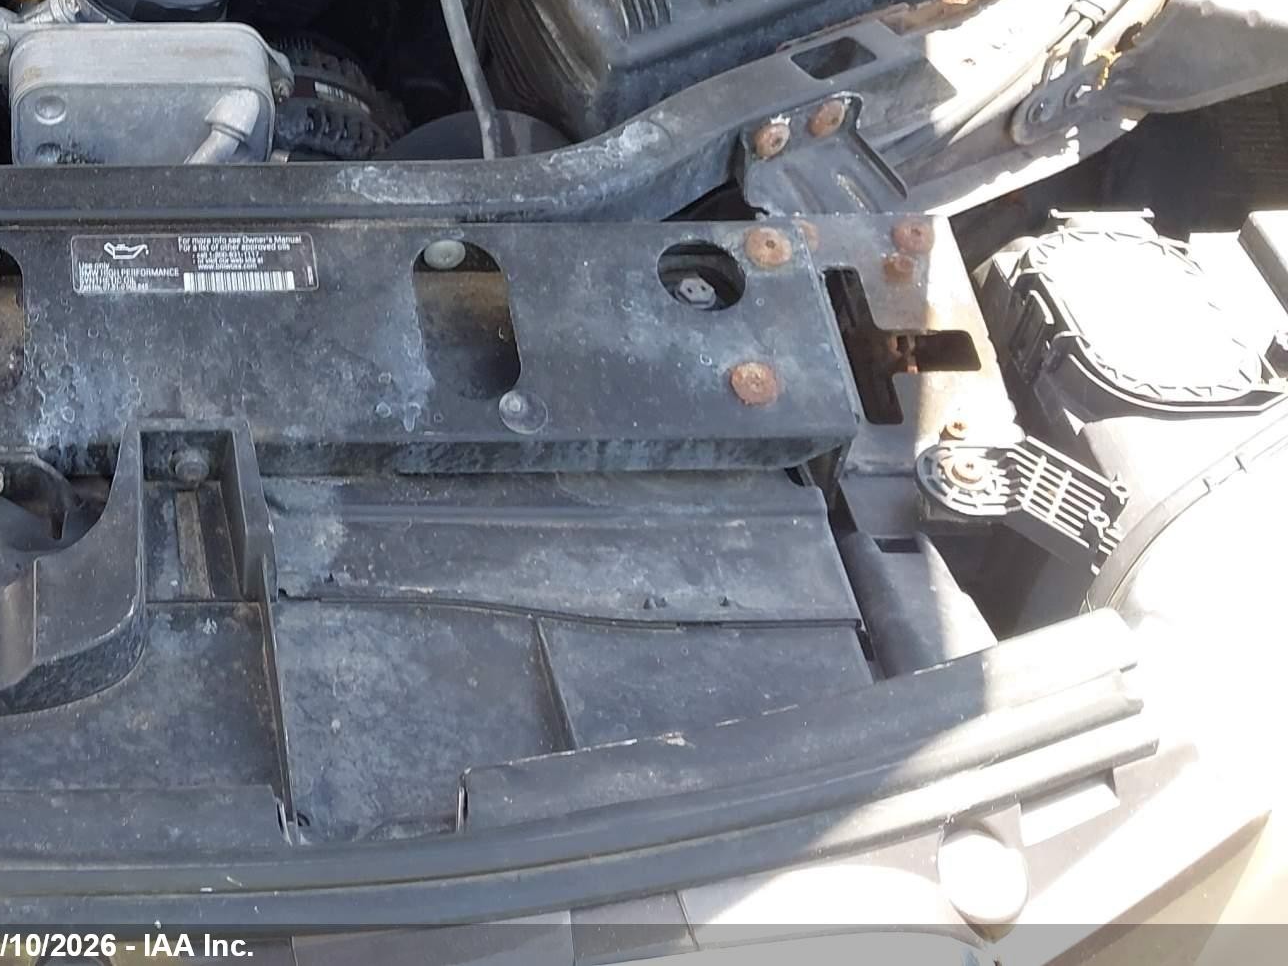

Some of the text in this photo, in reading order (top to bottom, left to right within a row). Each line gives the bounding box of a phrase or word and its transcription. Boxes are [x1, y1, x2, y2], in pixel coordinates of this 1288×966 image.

[242, 235, 273, 243] Owner's
[274, 234, 302, 243] Manual
[120, 267, 180, 277] PERFORMANCE
